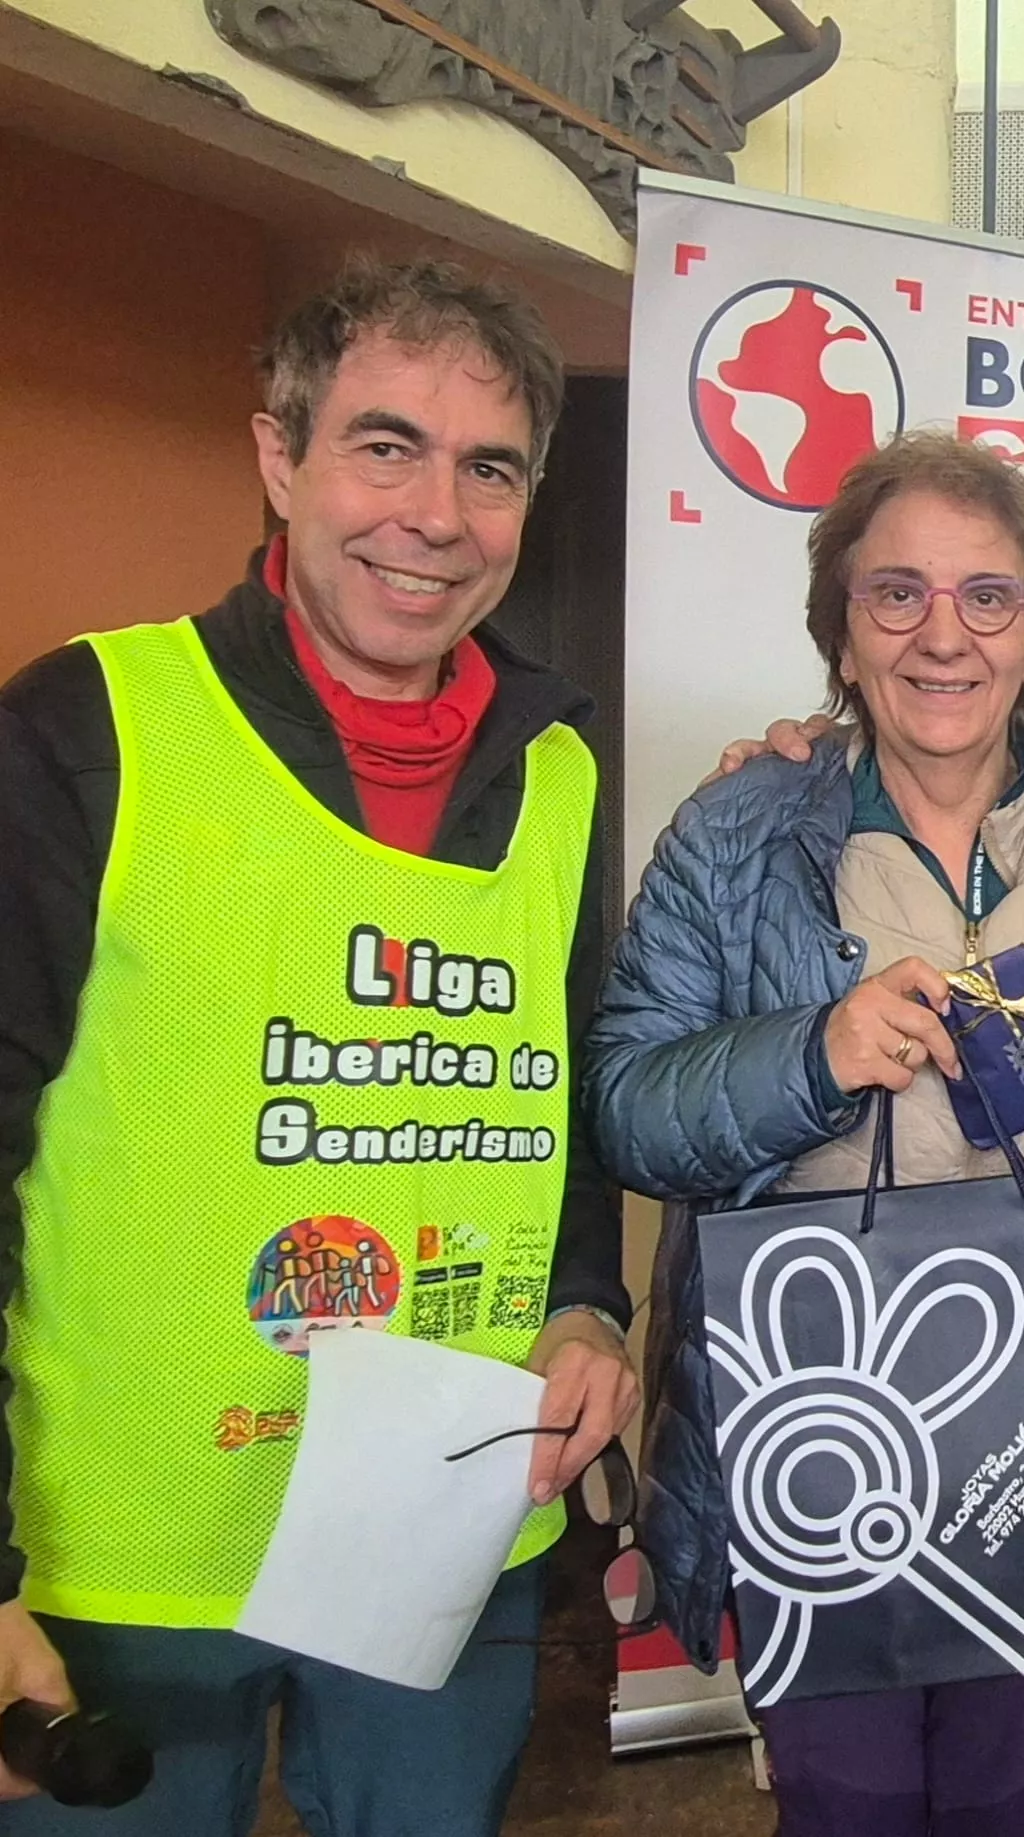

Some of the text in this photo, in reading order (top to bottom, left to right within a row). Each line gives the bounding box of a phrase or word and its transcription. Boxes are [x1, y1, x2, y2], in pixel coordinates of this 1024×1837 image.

[346, 923, 516, 1017] Liga
[262, 1016, 558, 1089] iberica de
[257, 1096, 556, 1167] Senderismo
[961, 1453, 998, 1500] JOYAS
[939, 1483, 994, 1544] GLORIA
